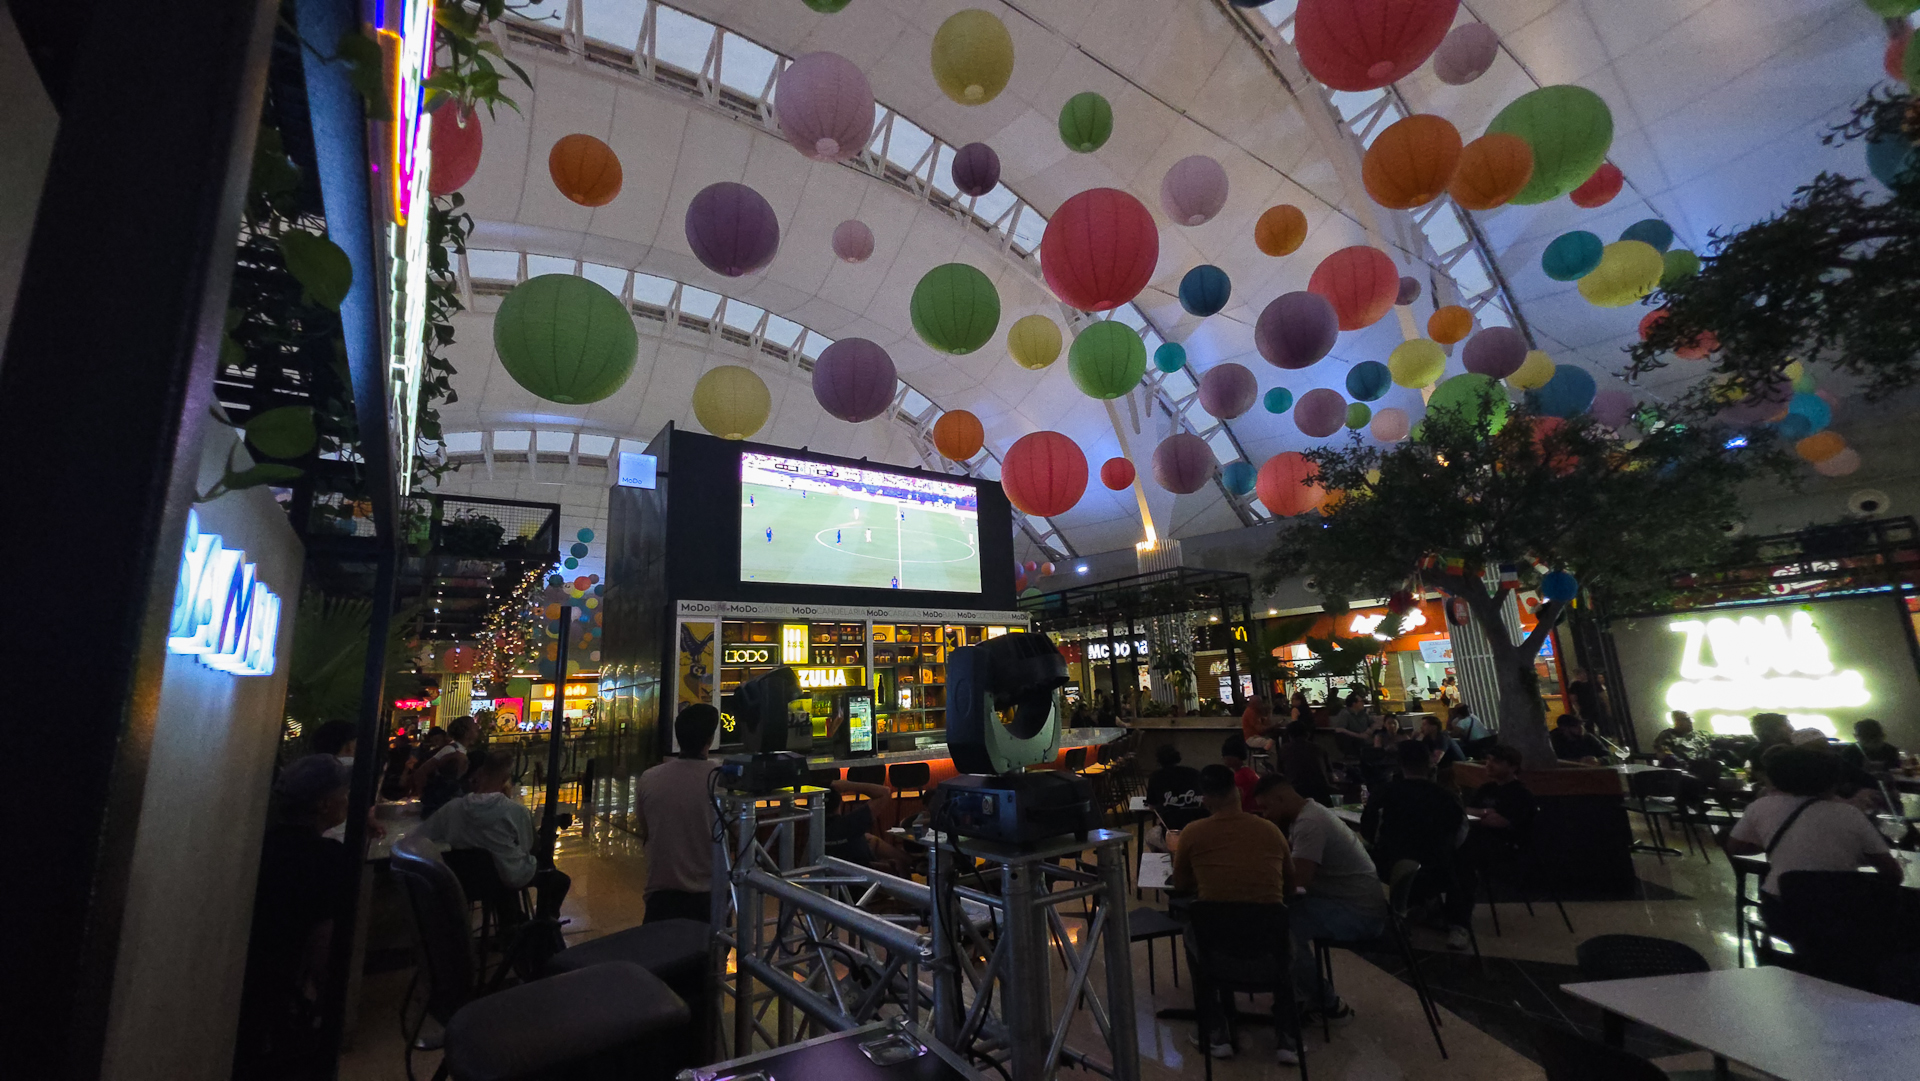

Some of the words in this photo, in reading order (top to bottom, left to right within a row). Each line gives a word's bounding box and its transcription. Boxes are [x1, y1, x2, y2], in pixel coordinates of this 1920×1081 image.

[621, 477, 643, 485] MoDo
[681, 603, 710, 612] MoDo
[730, 604, 758, 613] MoDo
[792, 607, 817, 615] MoDo
[866, 609, 889, 617] MoDo
[923, 610, 943, 618] MoDo
[1011, 613, 1029, 621] MoDo
[798, 669, 847, 687] ZULIA
[544, 684, 588, 697] Dado
